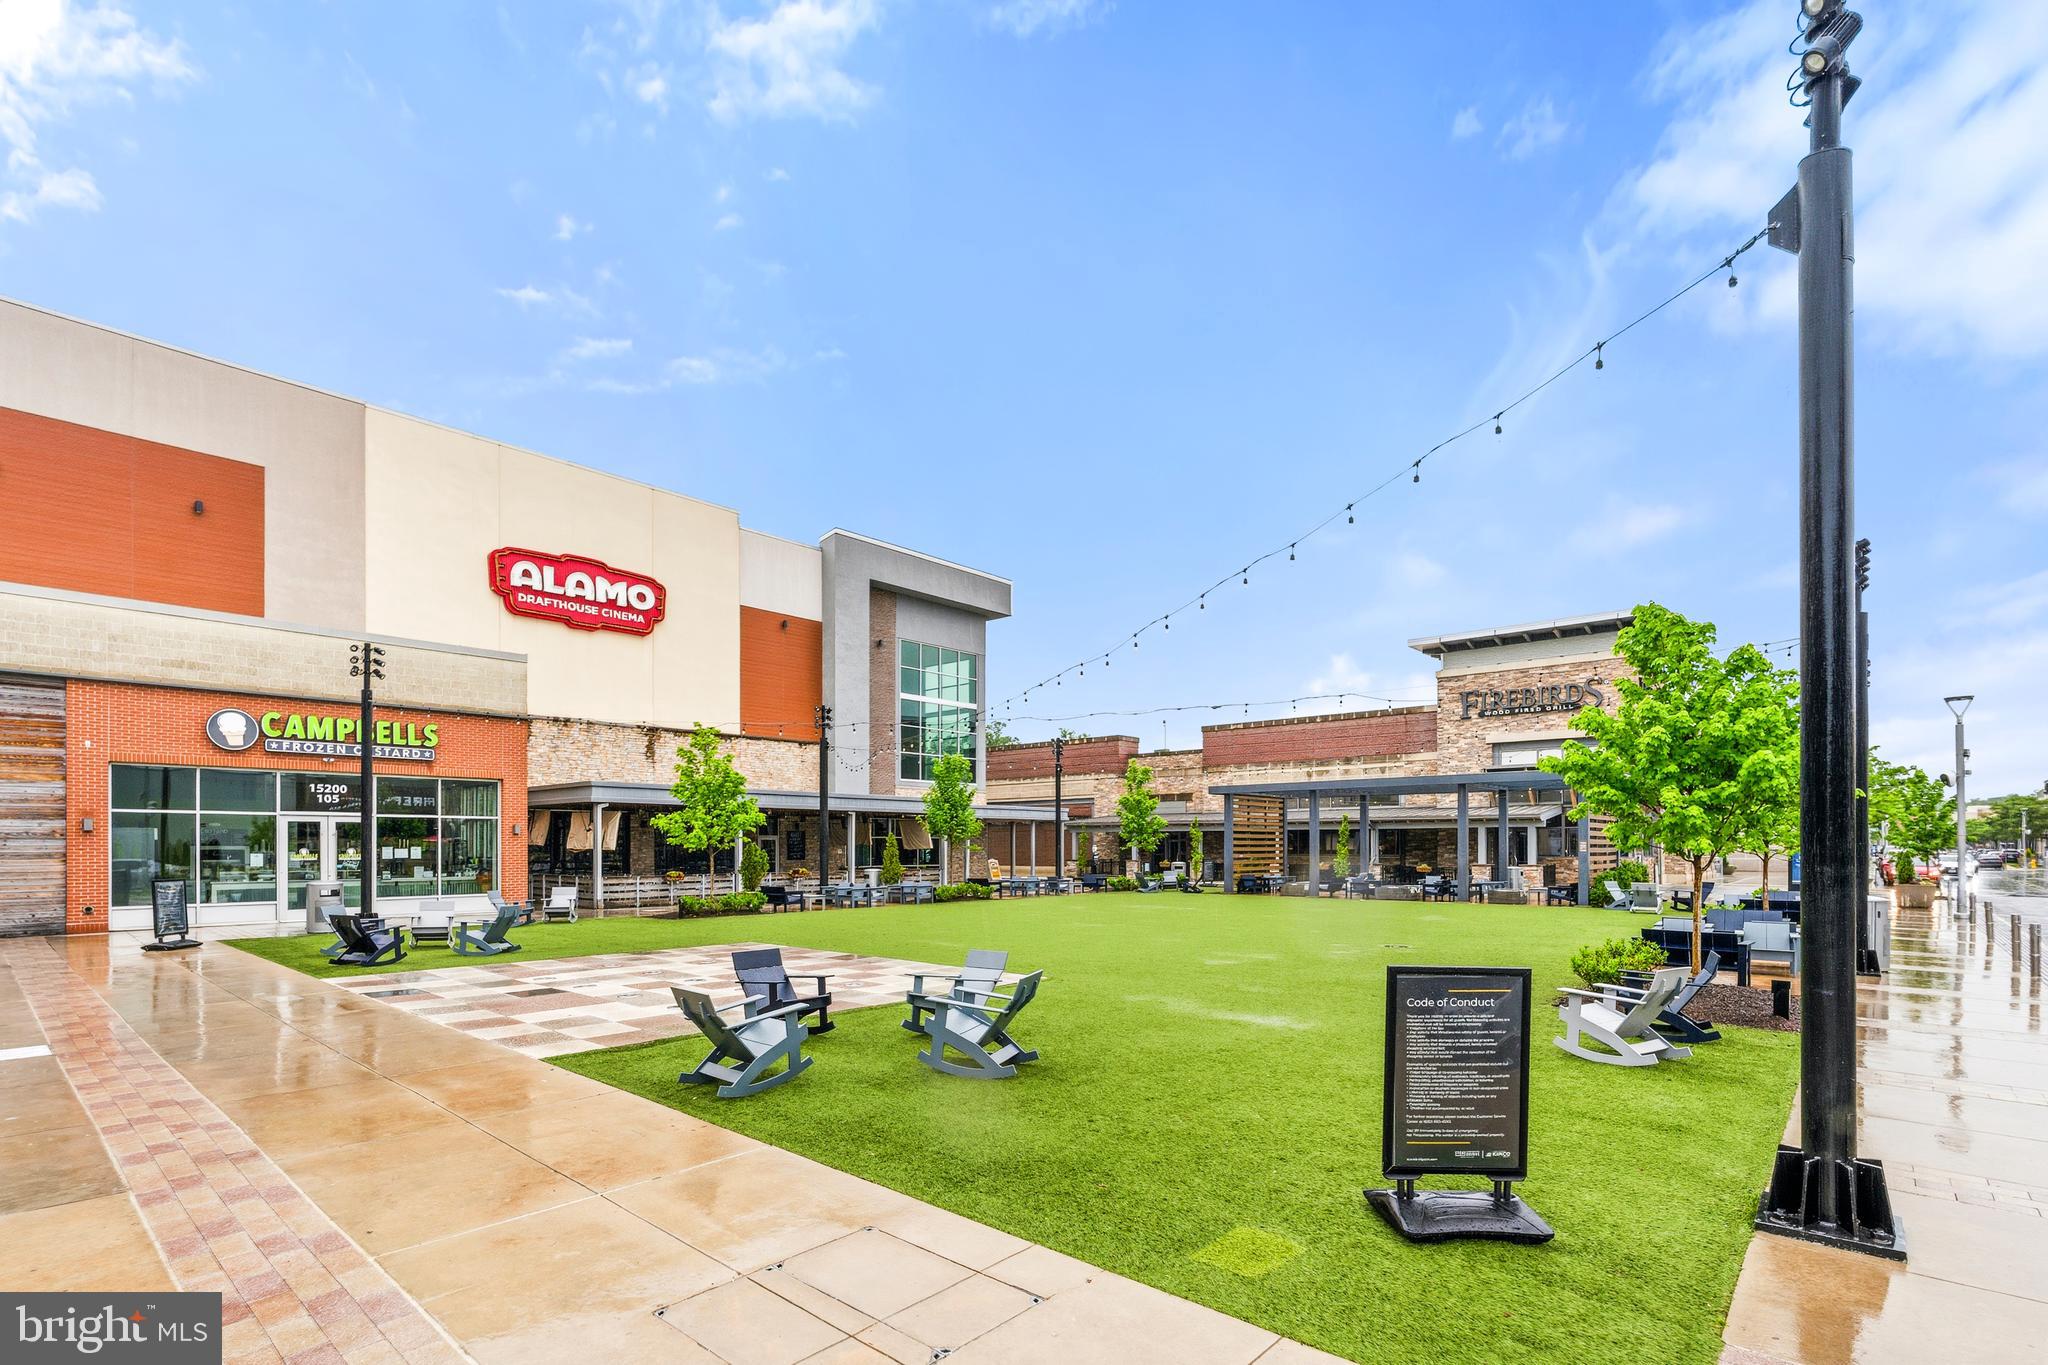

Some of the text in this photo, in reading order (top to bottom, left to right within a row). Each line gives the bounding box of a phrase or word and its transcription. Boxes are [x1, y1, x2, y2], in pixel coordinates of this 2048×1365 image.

[509, 560, 656, 611] ALAMO
[517, 592, 646, 624] DRAFTHOUSE CINEMA
[1460, 676, 1604, 720] FIREBIRDS
[1484, 709, 1511, 717] WOOD
[1545, 703, 1574, 711] GRILL
[282, 741, 421, 758] FROZEN CSTARD
[309, 783, 348, 794] 15200
[316, 794, 340, 804] 105
[1406, 997, 1496, 1007] Code of Conduct
